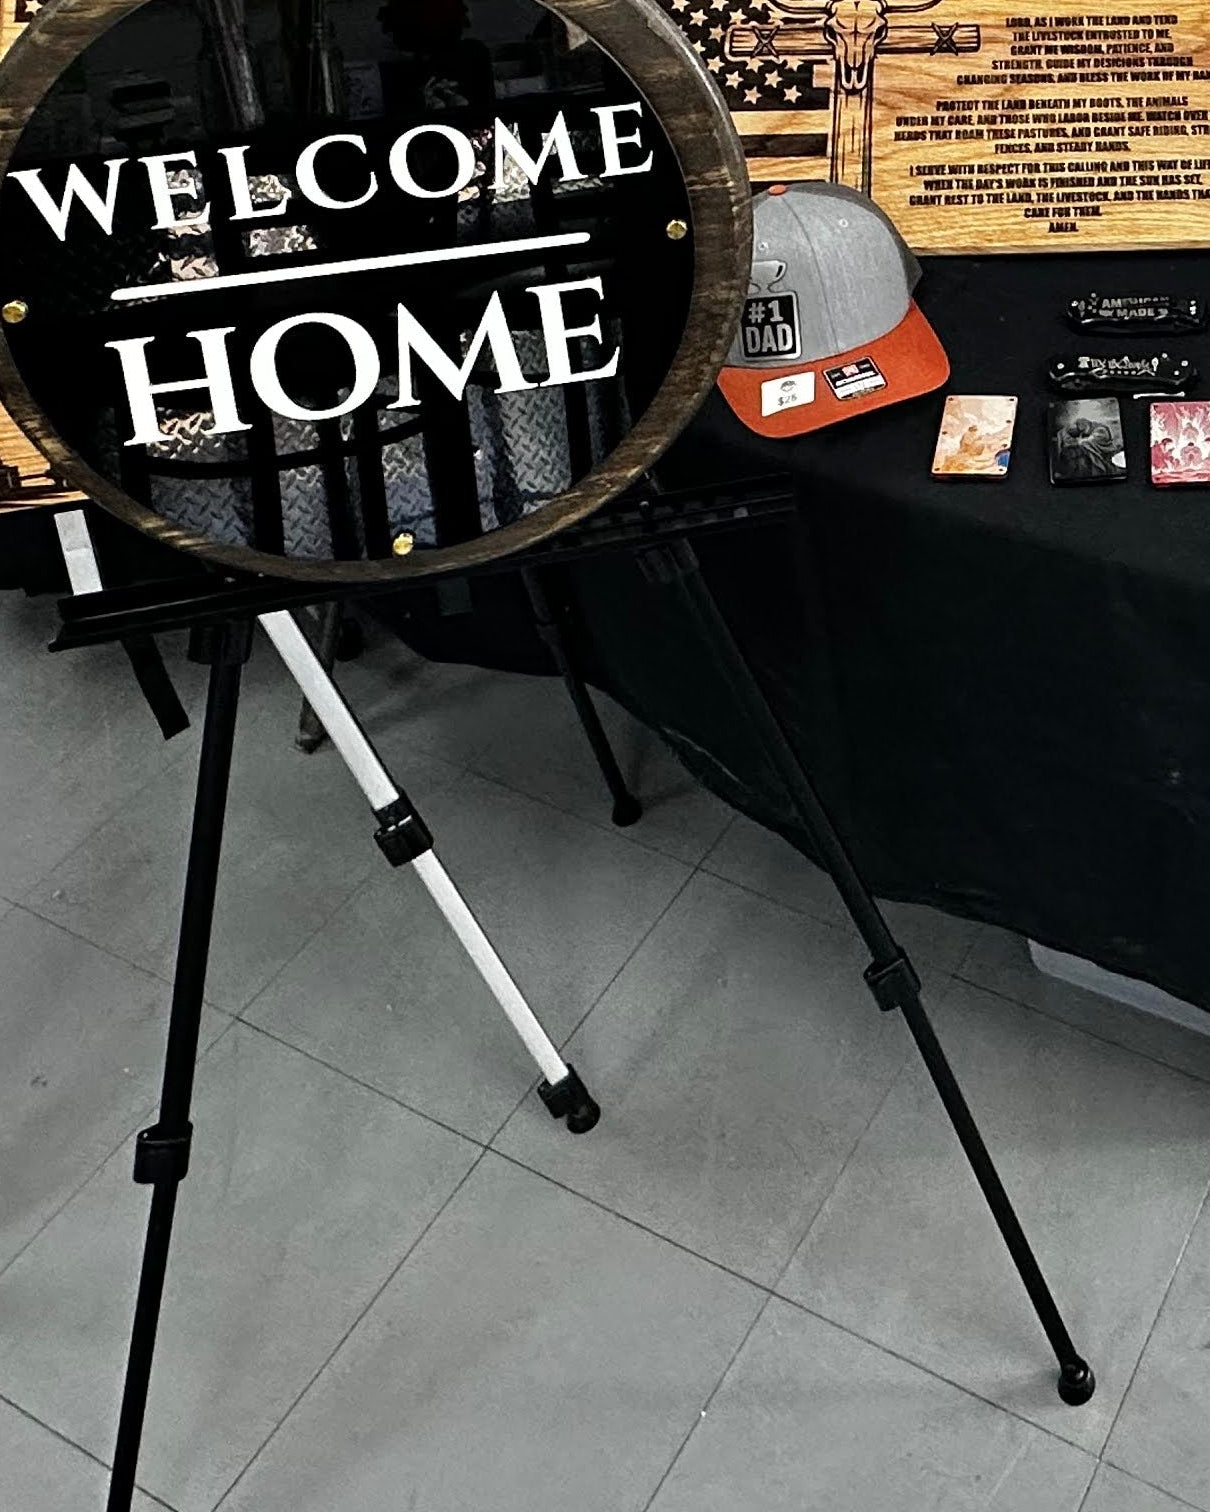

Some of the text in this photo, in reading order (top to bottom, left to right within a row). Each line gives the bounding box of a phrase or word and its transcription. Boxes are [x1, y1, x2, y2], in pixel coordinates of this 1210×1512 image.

[1035, 17, 1047, 27] AS
[1087, 16, 1103, 26] THE
[1132, 15, 1152, 25] AND
[1012, 31, 1029, 41] THE
[1142, 29, 1154, 39] TO
[1154, 43, 1174, 52] AND
[1077, 59, 1091, 68] MY
[1111, 72, 1128, 82] THE
[1130, 72, 1160, 81] WORK
[1176, 71, 1191, 80] MY
[982, 100, 999, 110] THE
[1073, 99, 1086, 108] MY
[1126, 97, 1143, 107] THE
[1146, 96, 1188, 107] ANIMALS
[931, 116, 946, 126] MY
[929, 130, 953, 140] THAT
[1072, 127, 1091, 137] AND
[1094, 127, 1125, 137] GRANT
[1128, 126, 1150, 136] SAFE
[7, 101, 655, 241] WELCOME
[977, 164, 1020, 174] RESPECT
[1022, 163, 1040, 174] FOR
[1043, 163, 1065, 173] THIS
[1068, 162, 1108, 172] CALLING
[1110, 161, 1129, 171] AND
[1133, 160, 1154, 171] THIS
[956, 179, 973, 189] THE
[1096, 176, 1117, 186] AND
[1120, 176, 1137, 186] THE
[910, 195, 942, 205] GRANT
[944, 195, 969, 205] REST
[971, 194, 984, 204] TO
[986, 194, 1004, 203] THE
[1036, 193, 1054, 202] THE
[1114, 191, 1134, 201] AND
[1136, 190, 1154, 200] THE
[1024, 208, 1050, 218] CARE
[1052, 207, 1071, 217] FOR
[748, 300, 784, 323] #1
[746, 324, 793, 354] DAD
[106, 276, 621, 447] HOME
